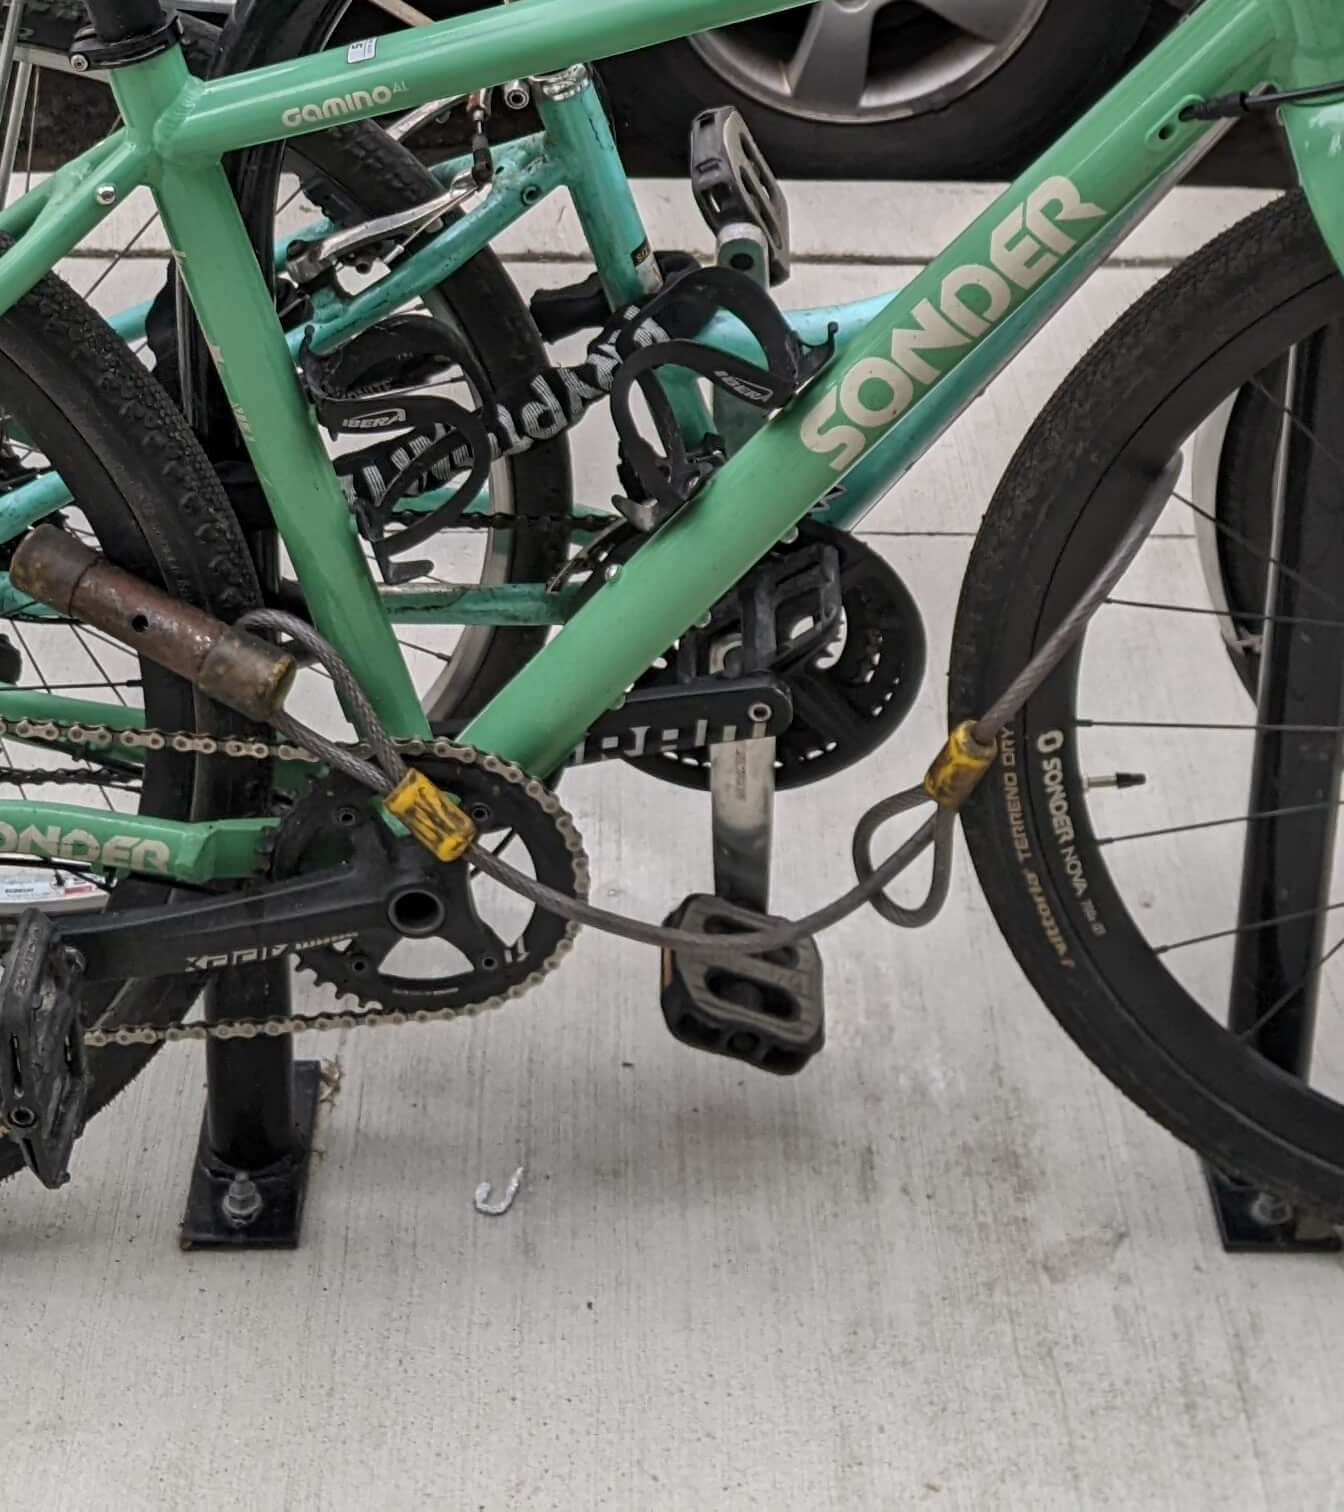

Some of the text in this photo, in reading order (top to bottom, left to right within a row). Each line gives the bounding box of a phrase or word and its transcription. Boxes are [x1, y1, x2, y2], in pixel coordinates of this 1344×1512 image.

[800, 175, 1107, 472] SONDER
[342, 408, 406, 428] IBERA
[1003, 772, 1033, 863] TERRENO
[1042, 757, 1088, 897] SONDER NOVA
